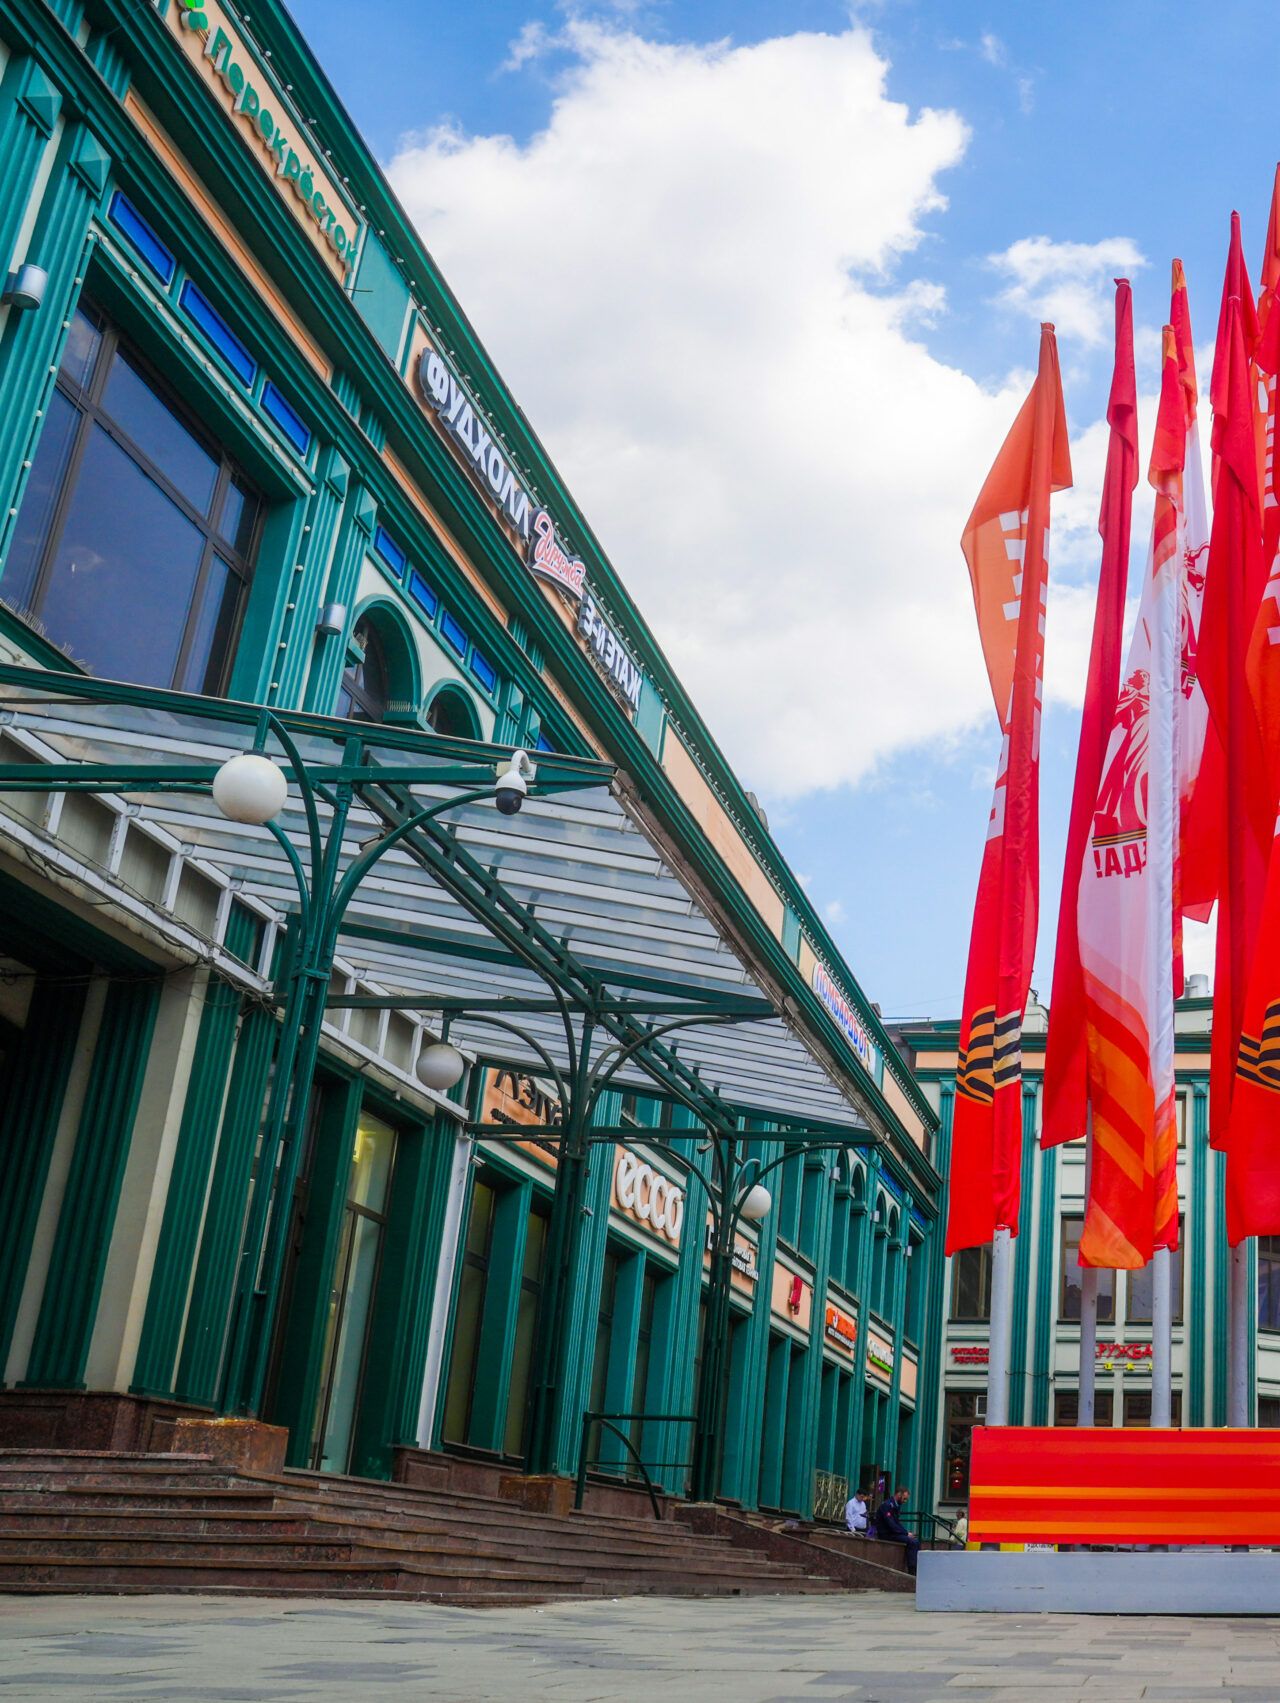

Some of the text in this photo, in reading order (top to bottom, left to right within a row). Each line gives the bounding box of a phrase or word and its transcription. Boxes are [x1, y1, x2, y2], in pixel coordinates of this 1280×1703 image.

[206, 25, 358, 272] Перекрёсток
[424, 350, 530, 542] ФУДХОЛЛ
[534, 512, 586, 590] Дружба
[605, 630, 642, 711] ЭТАЖ
[616, 1151, 684, 1240] ecco
[1096, 1342, 1153, 1361] РУЖБА
